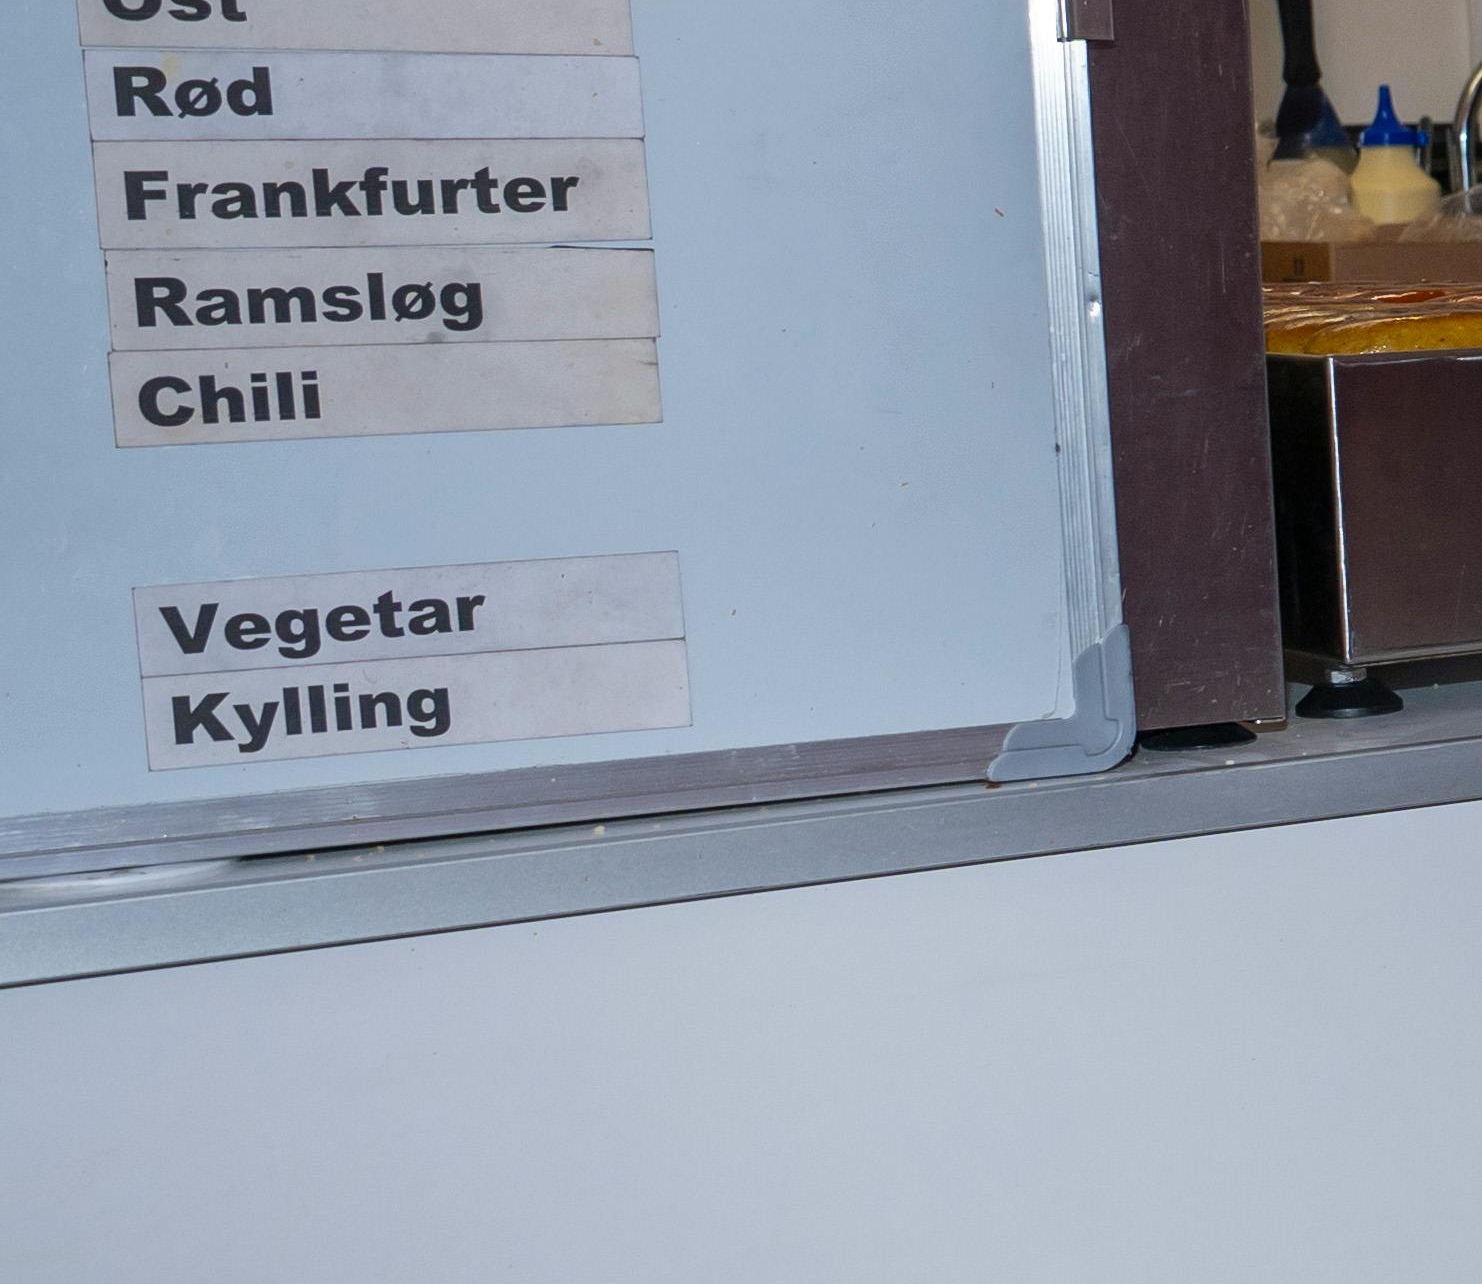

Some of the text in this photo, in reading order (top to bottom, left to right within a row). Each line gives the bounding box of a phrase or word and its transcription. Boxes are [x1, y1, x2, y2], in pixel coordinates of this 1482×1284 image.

[112, 65, 275, 119] Rød
[123, 166, 581, 221] Frankfurter
[133, 272, 486, 332] Ramsløg
[137, 370, 323, 428] Chili
[159, 590, 486, 660] Vegetar
[170, 681, 453, 755] Kylling
